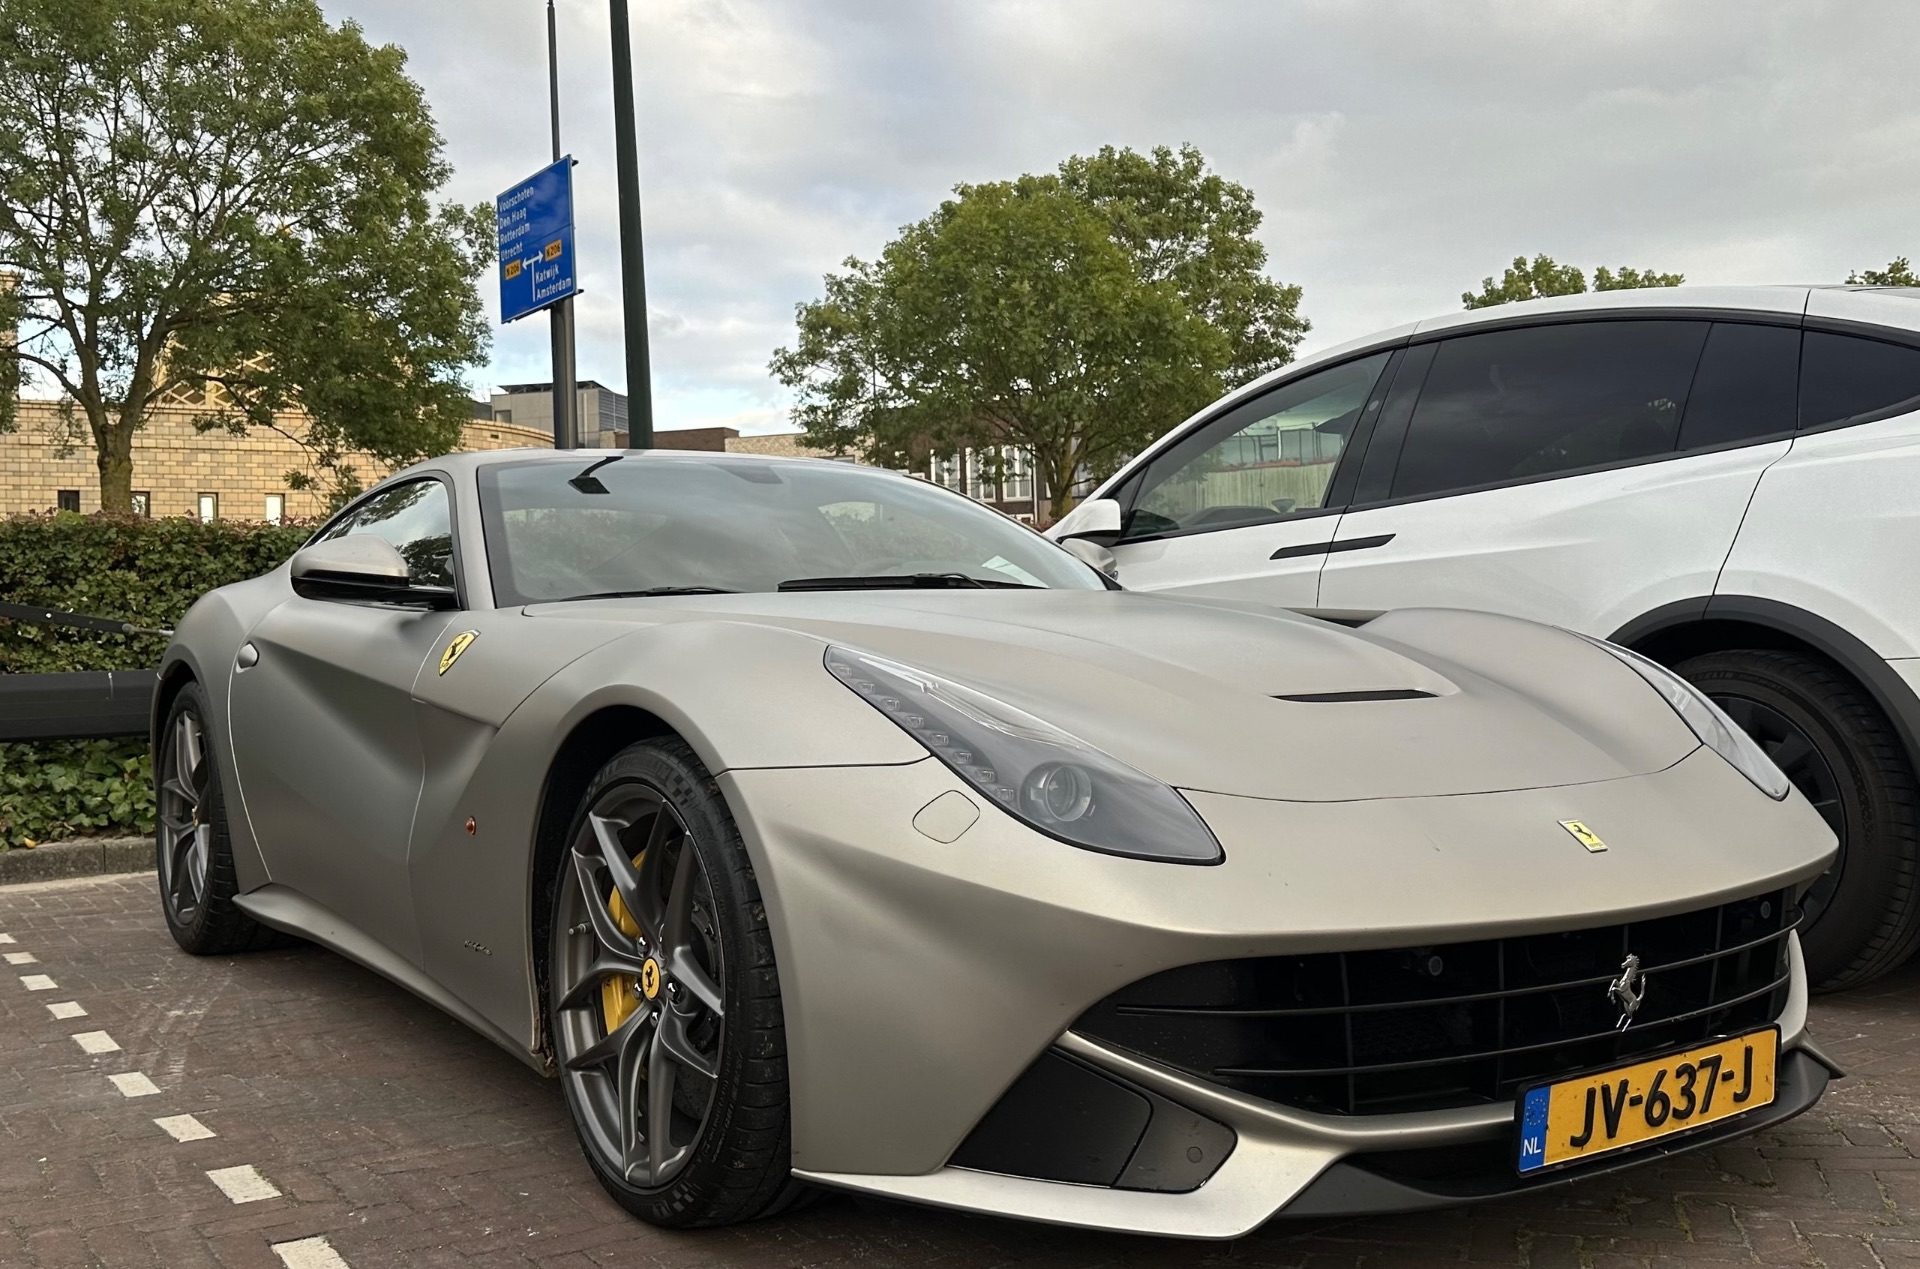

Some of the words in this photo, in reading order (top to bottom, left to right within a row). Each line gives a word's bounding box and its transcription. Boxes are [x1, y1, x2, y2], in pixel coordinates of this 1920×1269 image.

[499, 186, 534, 212] Voorschoten
[499, 216, 511, 230] Den
[511, 207, 527, 223] Haag
[500, 222, 530, 245] Rotterdam
[500, 242, 523, 262] Utrecht
[535, 264, 559, 284] Katwijk
[536, 276, 572, 300] Amsterdam
[1570, 1045, 1753, 1147] JV-637-J
[1523, 1137, 1541, 1156] NL
